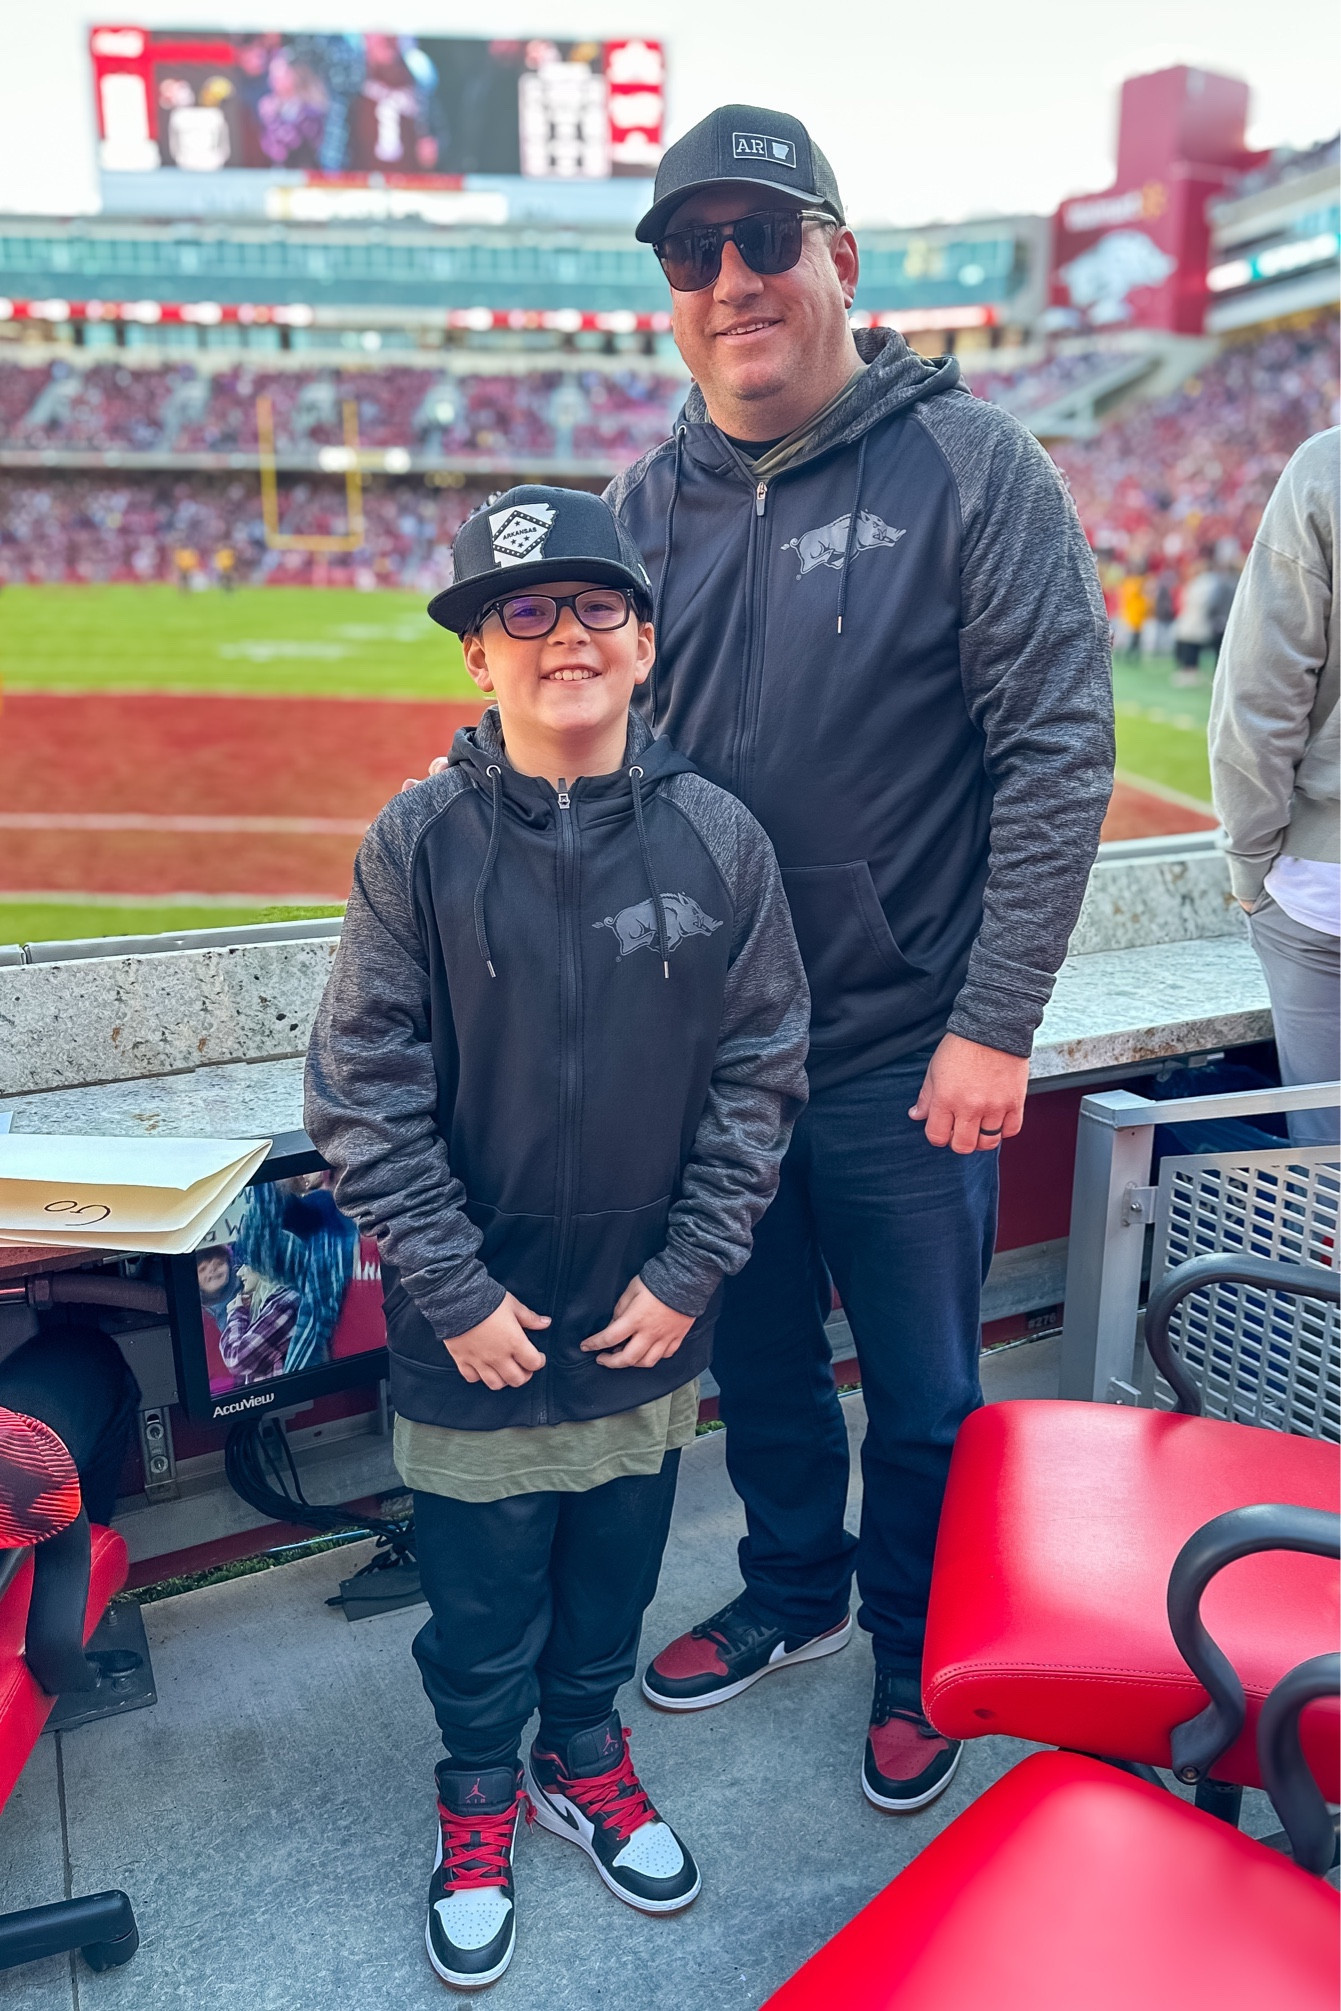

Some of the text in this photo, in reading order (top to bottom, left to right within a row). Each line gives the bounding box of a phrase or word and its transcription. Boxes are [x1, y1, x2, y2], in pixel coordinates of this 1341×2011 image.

[736, 138, 765, 154] AR
[503, 526, 538, 540] ARKANSAS
[212, 1392, 275, 1418] AccuView
